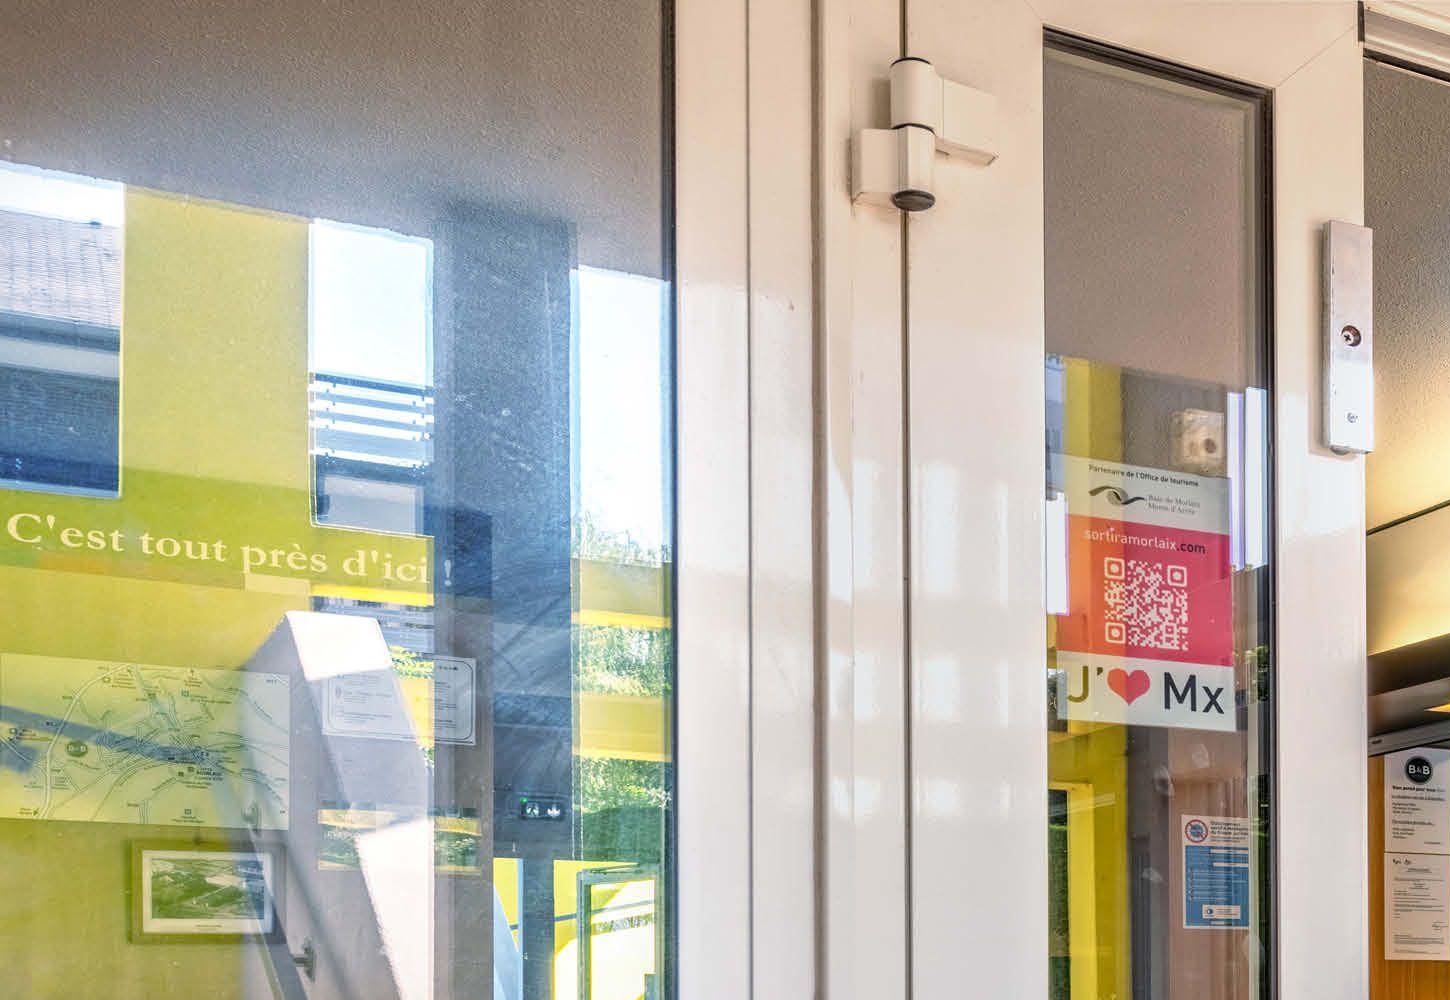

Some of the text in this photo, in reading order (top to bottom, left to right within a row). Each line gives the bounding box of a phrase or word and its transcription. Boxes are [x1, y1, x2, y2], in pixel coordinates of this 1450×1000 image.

[1170, 477, 1199, 486] tourisme
[7, 513, 125, 551] C'est
[139, 532, 227, 562] tout
[240, 543, 328, 575] près
[343, 550, 432, 584] d'ici
[1084, 527, 1206, 554] sortiramorlaix.com
[1164, 672, 1224, 714] Mx
[1408, 764, 1430, 775] B&B
